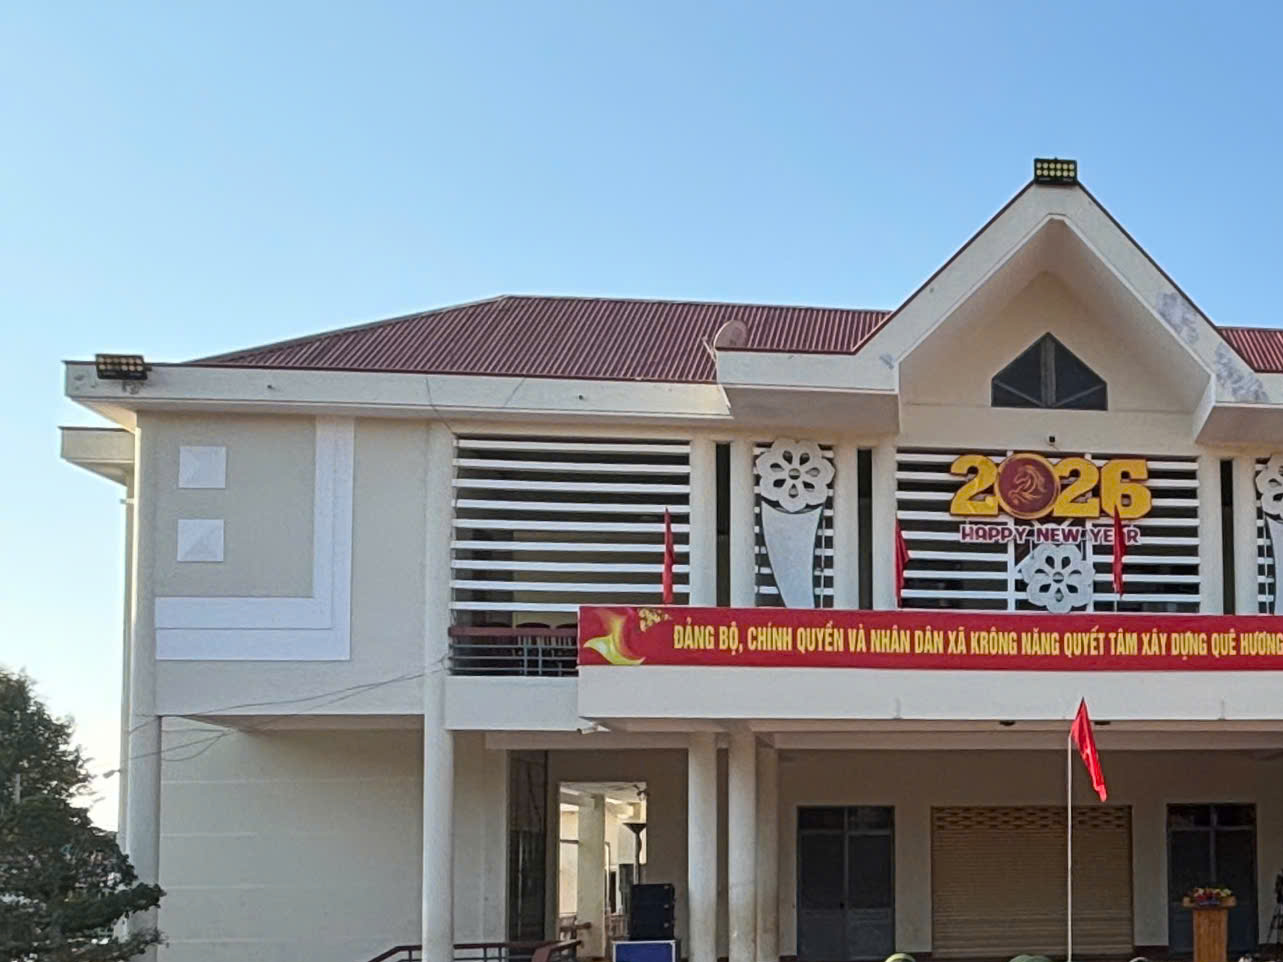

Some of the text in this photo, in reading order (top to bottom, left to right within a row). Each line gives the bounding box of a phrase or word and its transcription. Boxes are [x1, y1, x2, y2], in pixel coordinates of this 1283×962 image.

[950, 454, 1152, 520] 2026
[960, 525, 1141, 544] HAPPY NEW YER
[673, 616, 715, 649] ĐẢNG
[719, 621, 744, 656] BỘ,
[747, 622, 793, 651] CHÍNH
[848, 623, 867, 653] VÀ
[870, 625, 911, 653] NHÂN
[914, 626, 944, 654] DÂN
[948, 627, 967, 655] XÃ
[970, 626, 1018, 655] KRÔNG
[1021, 627, 1060, 656] NĂNG
[1063, 625, 1105, 658] QUYẾT
[1108, 628, 1138, 656] TÂM
[1141, 628, 1168, 656] XÂY
[1171, 631, 1208, 661] DỰNG
[1211, 628, 1236, 659] QUÊ
